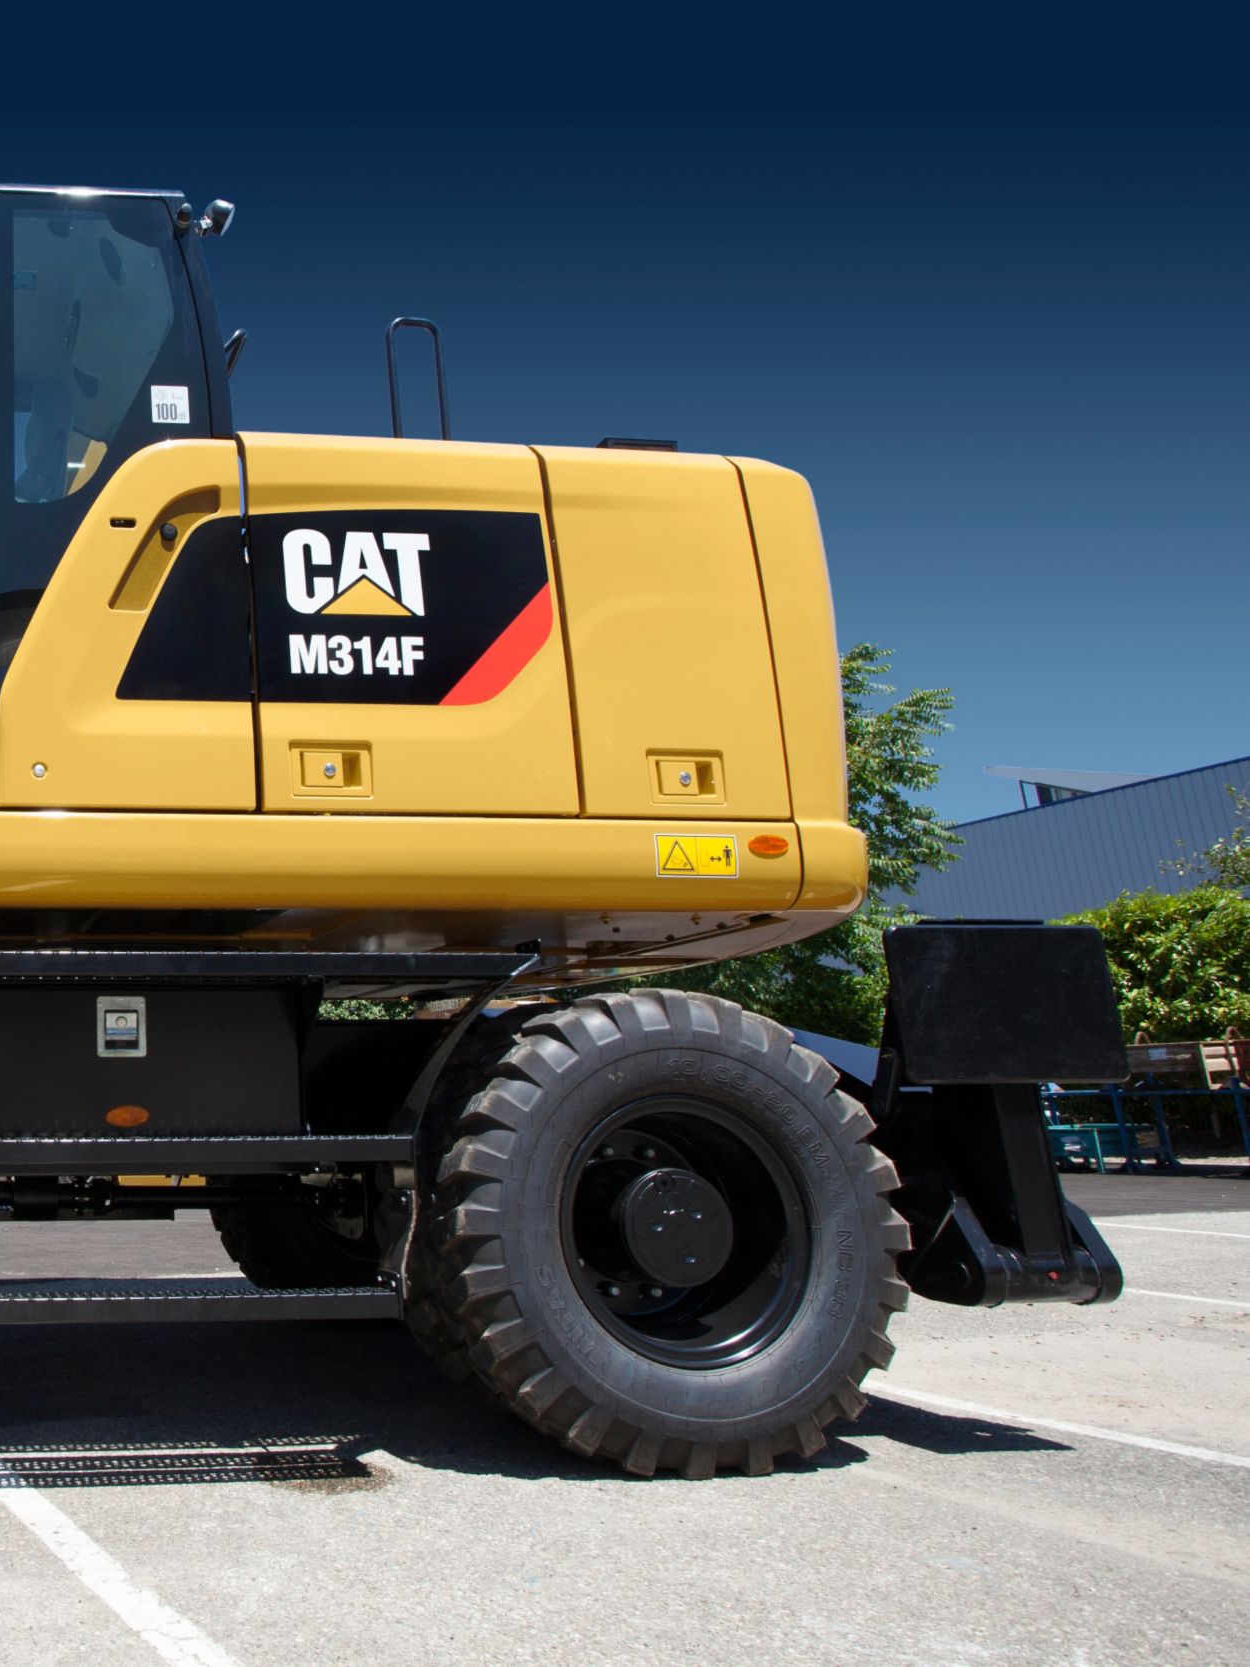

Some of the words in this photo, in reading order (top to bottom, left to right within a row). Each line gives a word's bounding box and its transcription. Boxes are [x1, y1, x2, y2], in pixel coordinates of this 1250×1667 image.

[155, 403, 178, 421] 100
[282, 528, 431, 617] CAT
[288, 633, 425, 676] M314F
